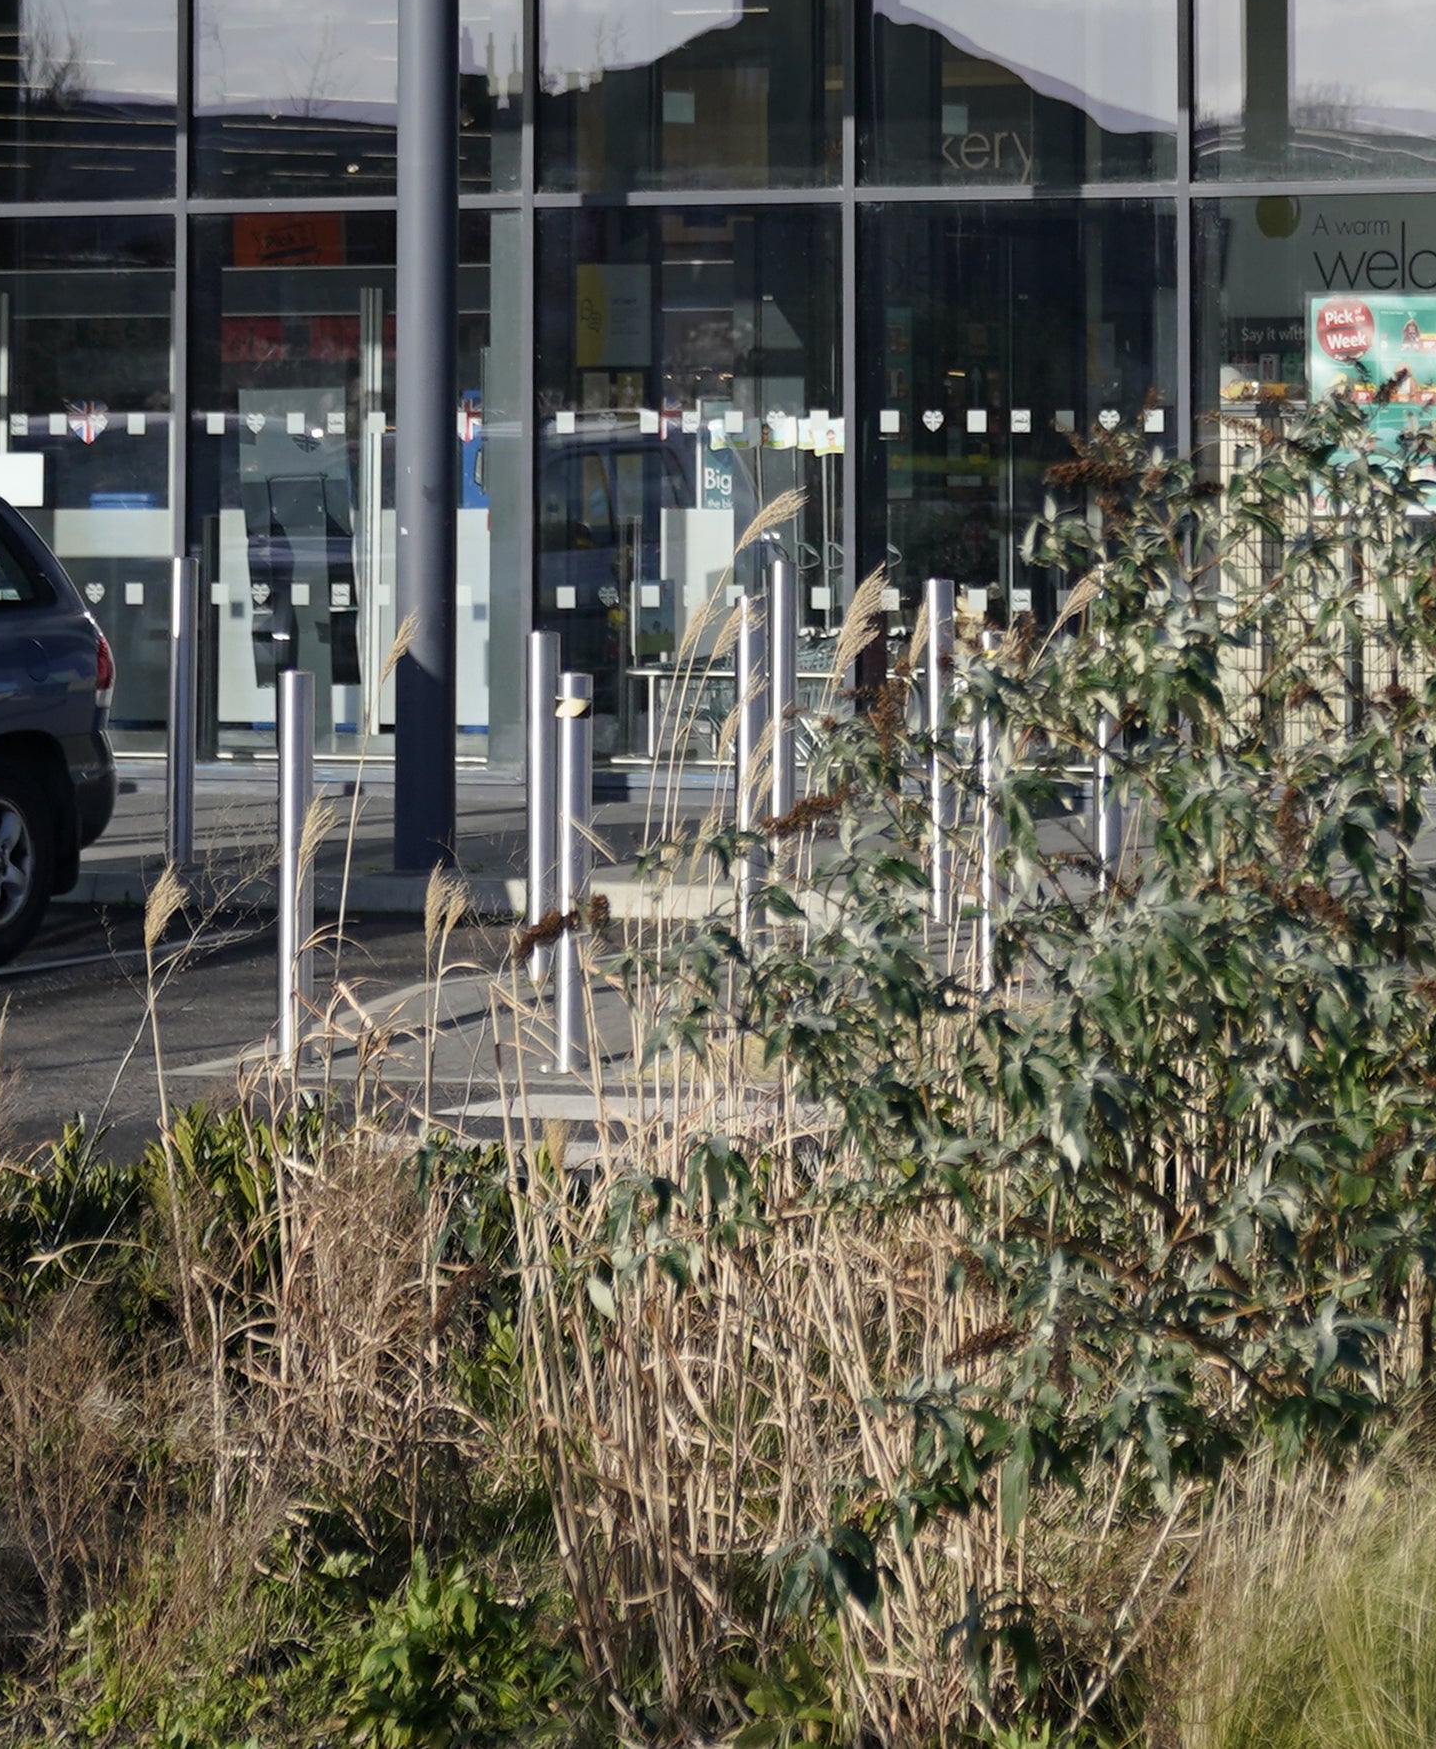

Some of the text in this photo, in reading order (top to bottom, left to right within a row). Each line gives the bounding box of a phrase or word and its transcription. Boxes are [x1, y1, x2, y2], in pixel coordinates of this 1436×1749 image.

[1313, 213, 1390, 236] A warm
[1324, 311, 1354, 326] Pick
[1242, 327, 1263, 344] Say
[1327, 332, 1367, 350] Week
[704, 467, 733, 495] Big
